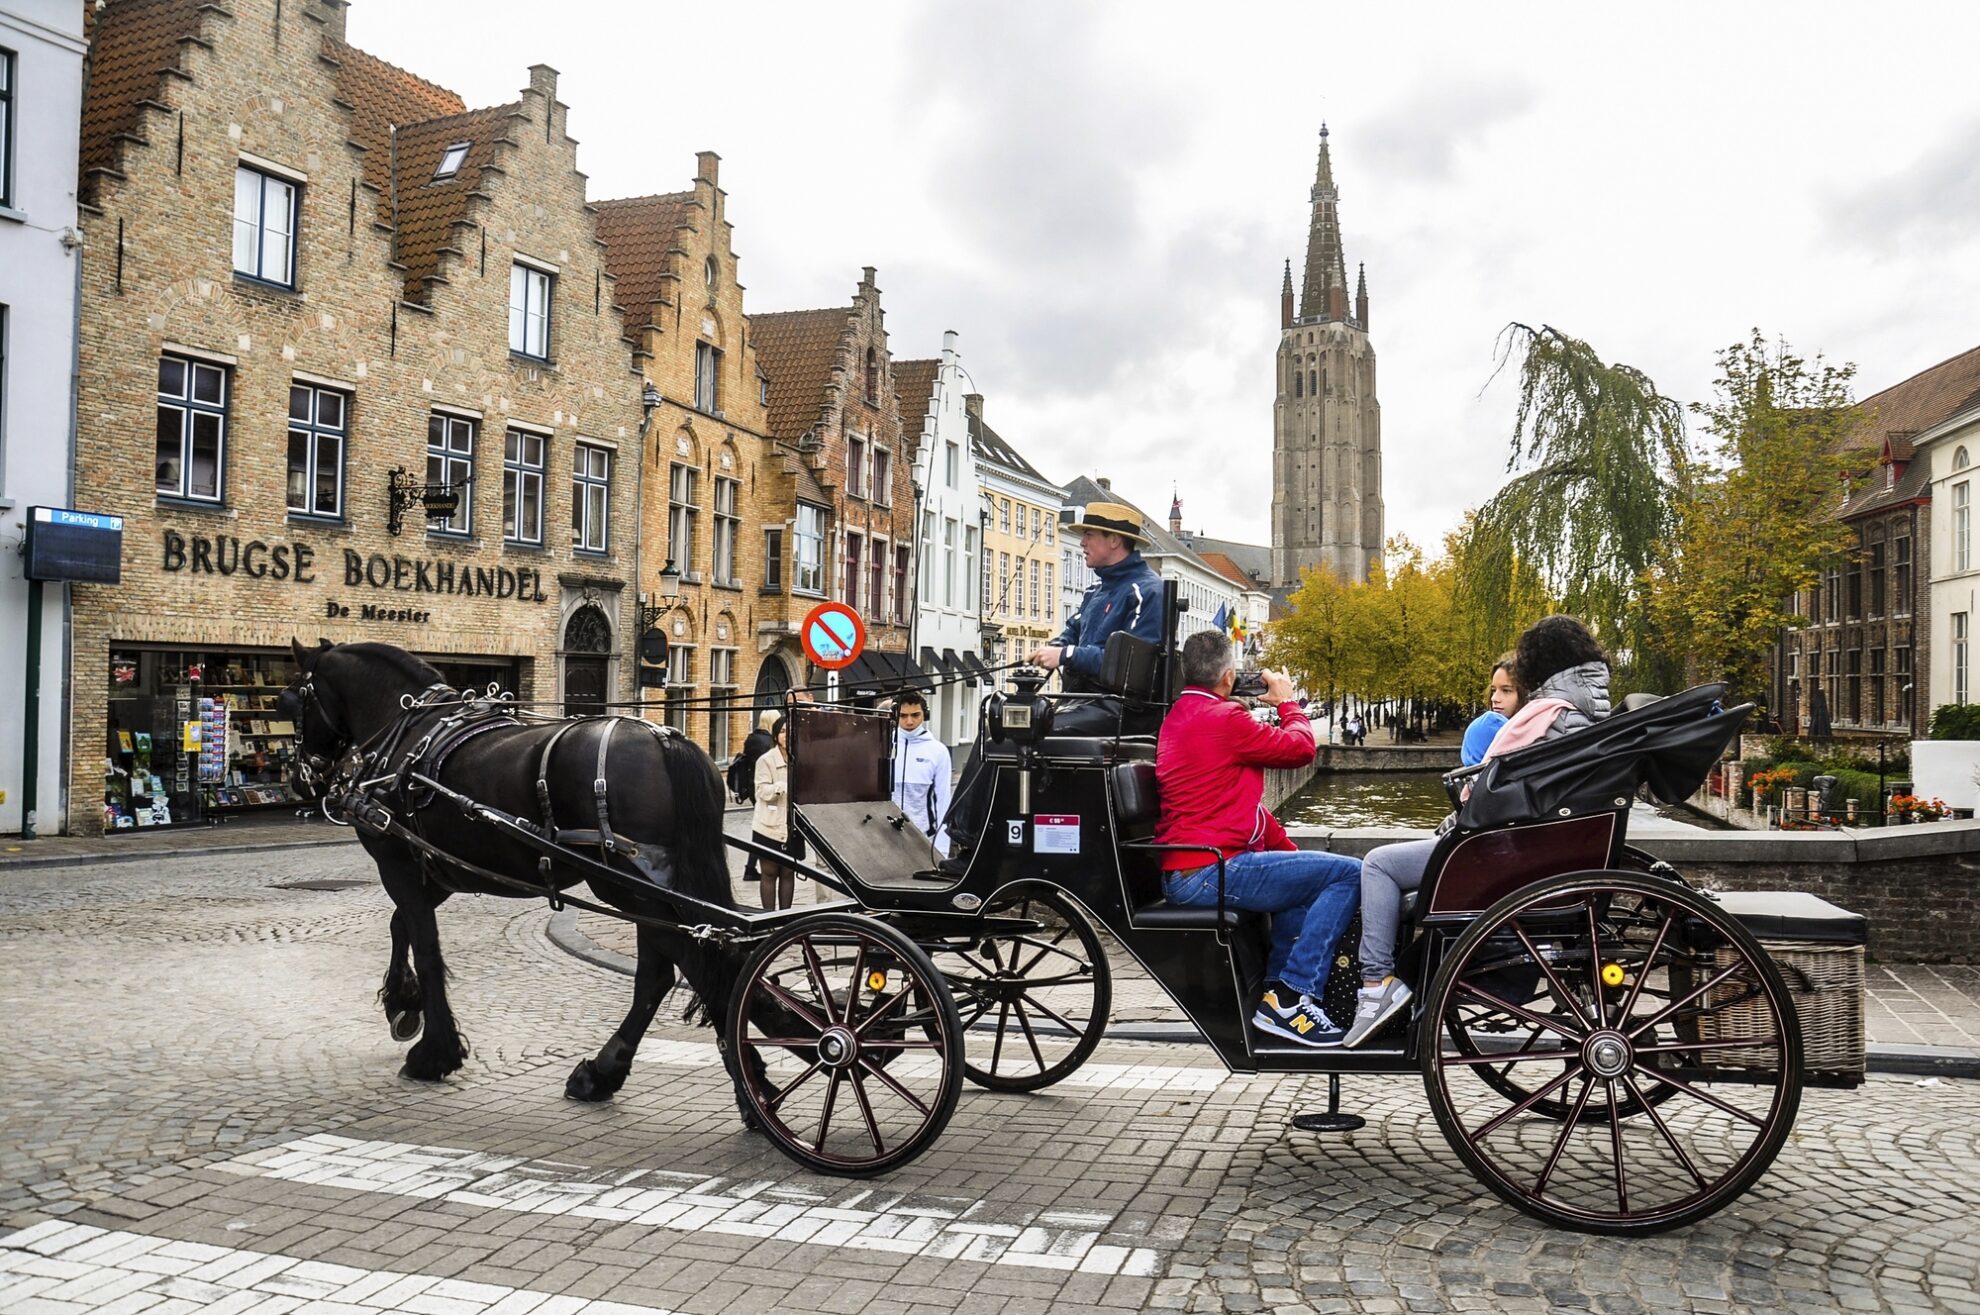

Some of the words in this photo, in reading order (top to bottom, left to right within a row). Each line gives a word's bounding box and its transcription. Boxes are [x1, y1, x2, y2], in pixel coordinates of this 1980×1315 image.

[61, 512, 99, 528] Parking
[163, 530, 316, 583] BRUGSE
[343, 549, 549, 602] BOEKHANDEL
[326, 601, 350, 618] De
[361, 604, 431, 623] Meester
[1010, 825, 1021, 839] 9
[1289, 1014, 1315, 1034] N
